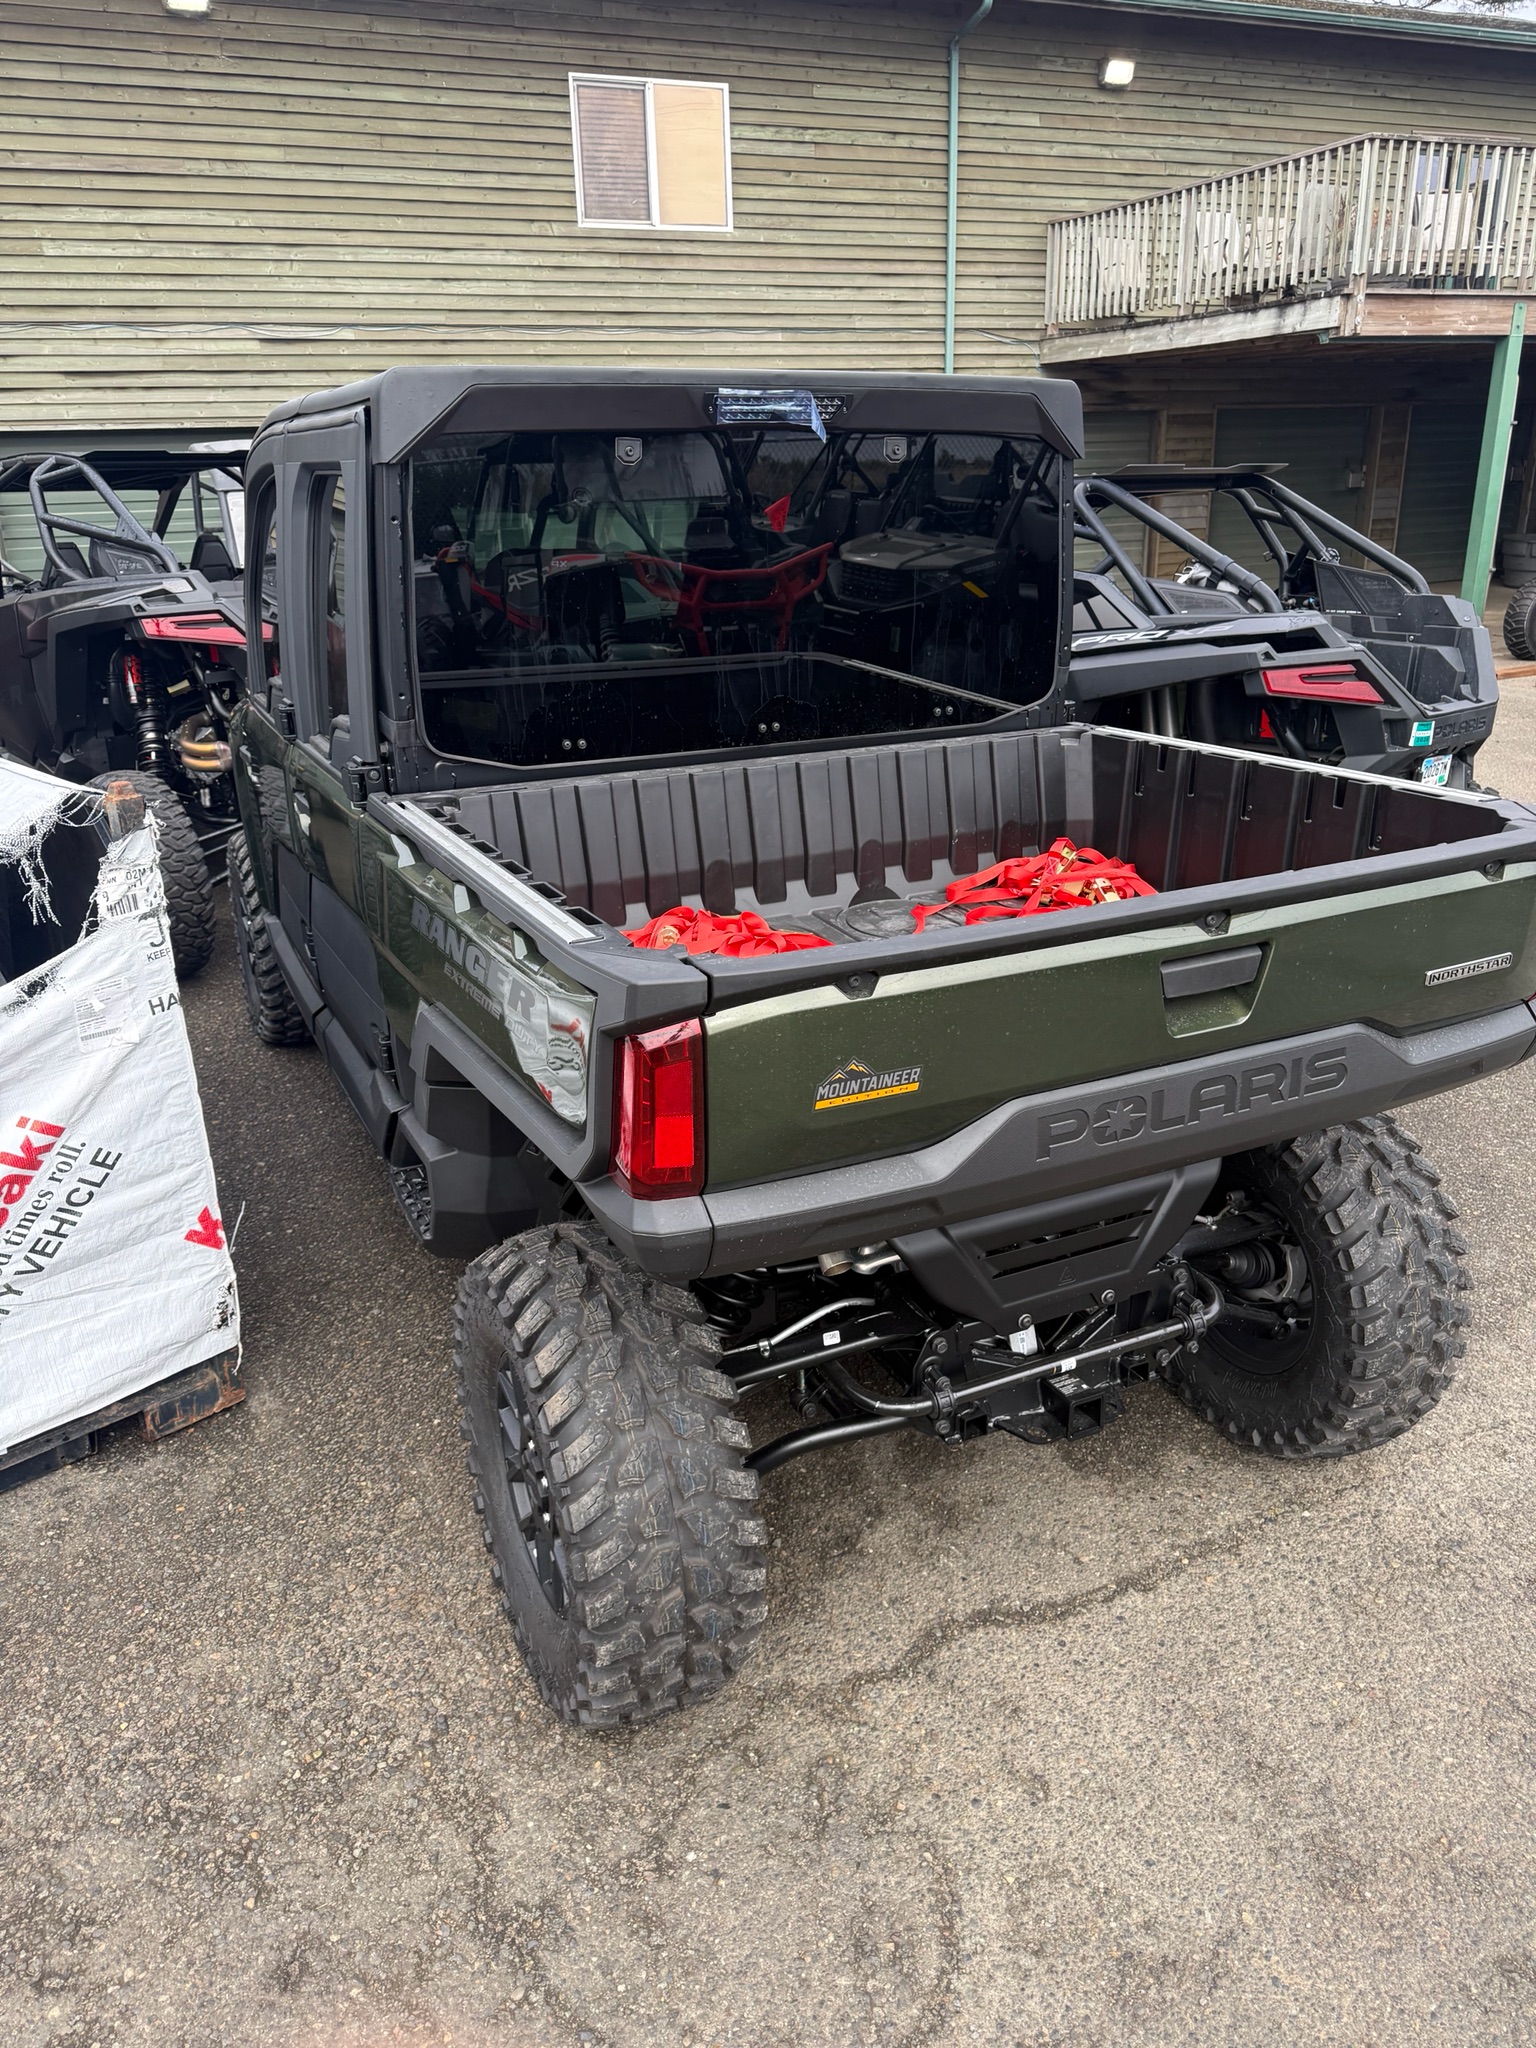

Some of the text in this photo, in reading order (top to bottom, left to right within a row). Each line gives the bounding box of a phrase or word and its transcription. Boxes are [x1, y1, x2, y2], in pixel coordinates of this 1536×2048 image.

[1071, 625, 1234, 649] PRO XP
[1434, 716, 1487, 738] POLARIS
[411, 897, 536, 1022] RANGER
[1431, 957, 1509, 983] NORTHSTAR
[148, 992, 180, 1016] HA
[444, 962, 544, 1054] EXTREME DUTY
[817, 1067, 921, 1100] MOUNTAINEER
[1036, 1047, 1349, 1162] POLARIS
[3, 1141, 87, 1247] times roll.
[13, 1147, 123, 1276] VEHICLE
